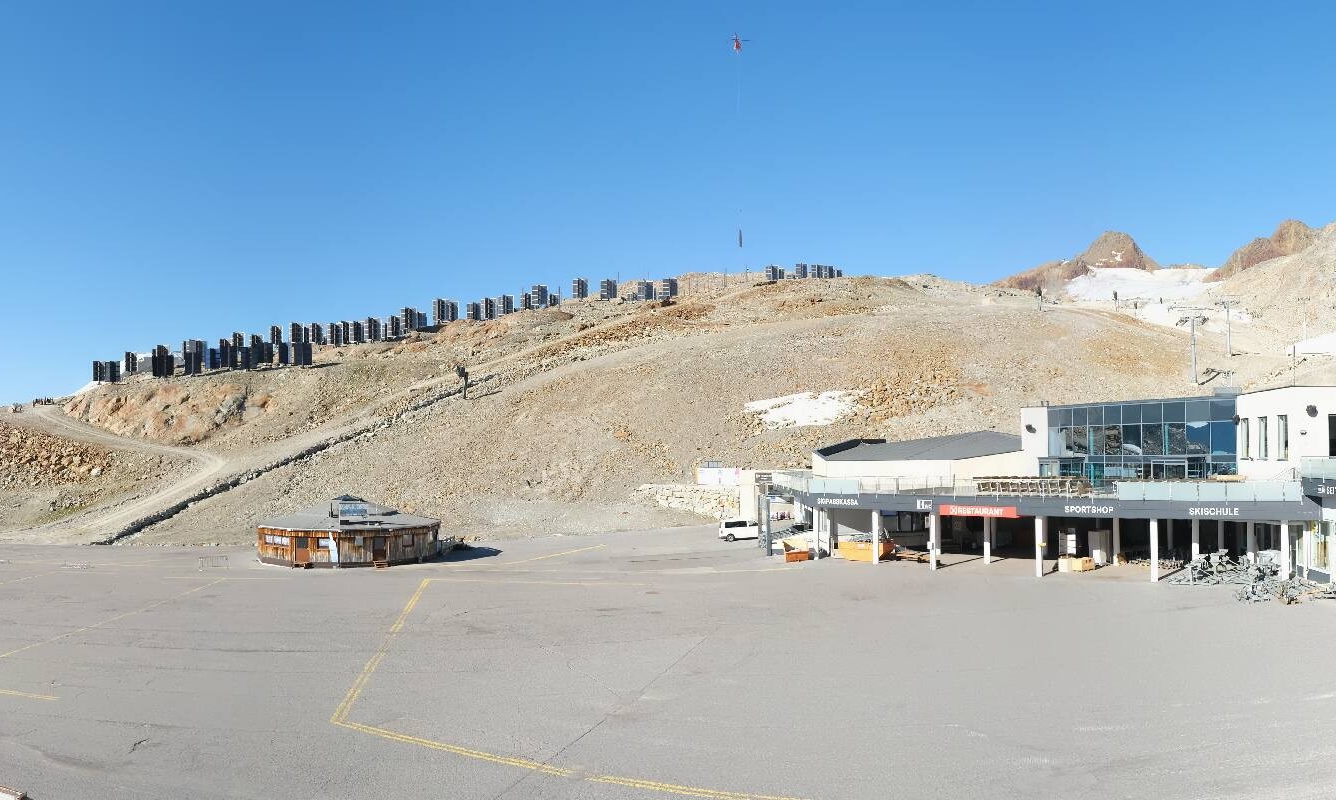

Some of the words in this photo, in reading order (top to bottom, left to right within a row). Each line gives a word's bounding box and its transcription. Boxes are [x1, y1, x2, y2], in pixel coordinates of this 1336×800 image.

[957, 506, 1004, 516] RESTAURANT
[1064, 505, 1114, 514] SPORTSHOP
[1189, 507, 1240, 516] SKISCHULE
